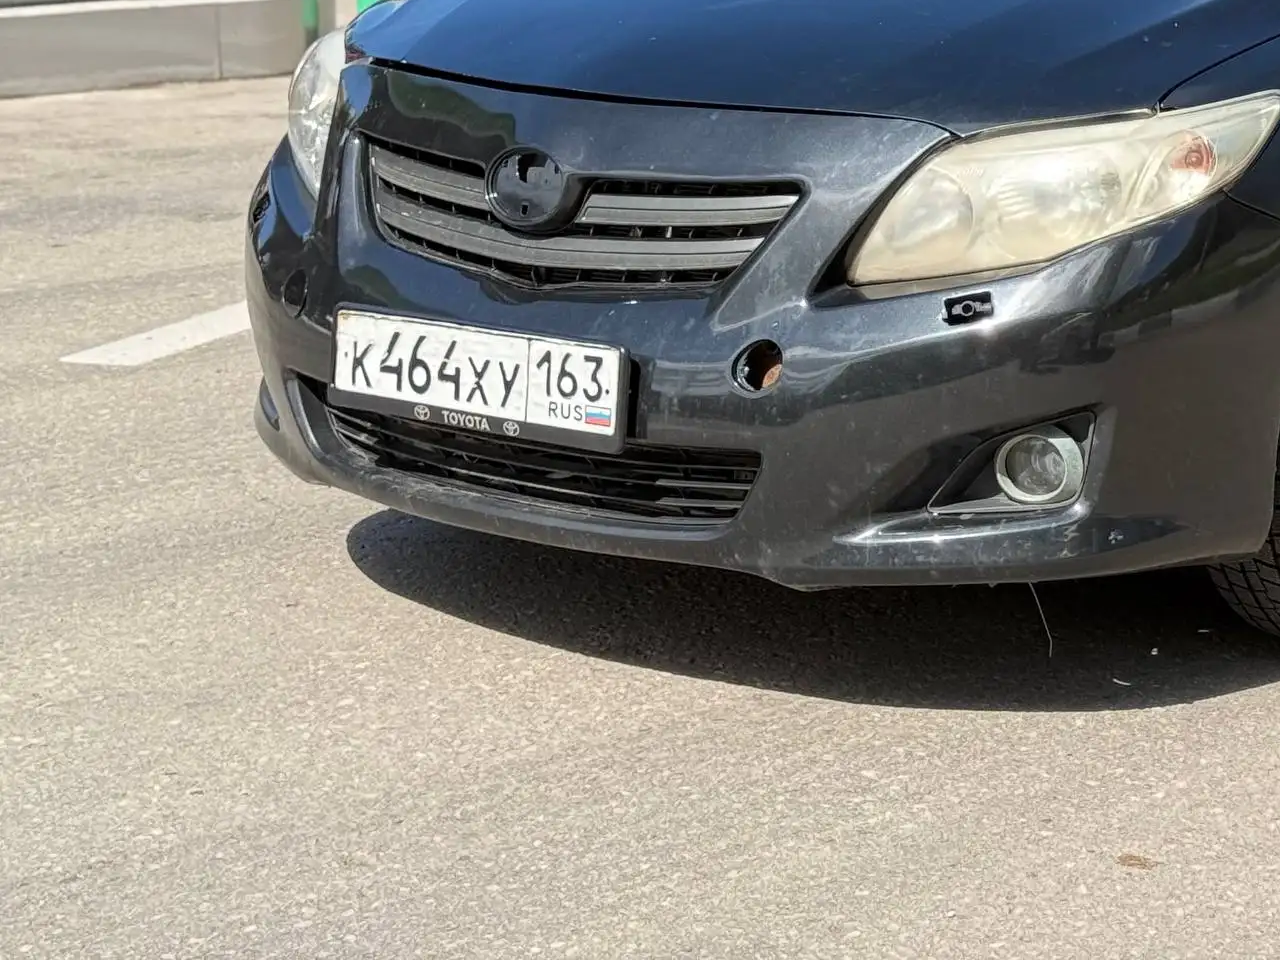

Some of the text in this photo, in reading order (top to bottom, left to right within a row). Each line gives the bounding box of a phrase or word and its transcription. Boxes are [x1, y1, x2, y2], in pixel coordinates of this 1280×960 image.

[352, 331, 603, 408] К464ХУ 163
[441, 410, 491, 432] TOYOTA
[548, 401, 583, 421] RUS
